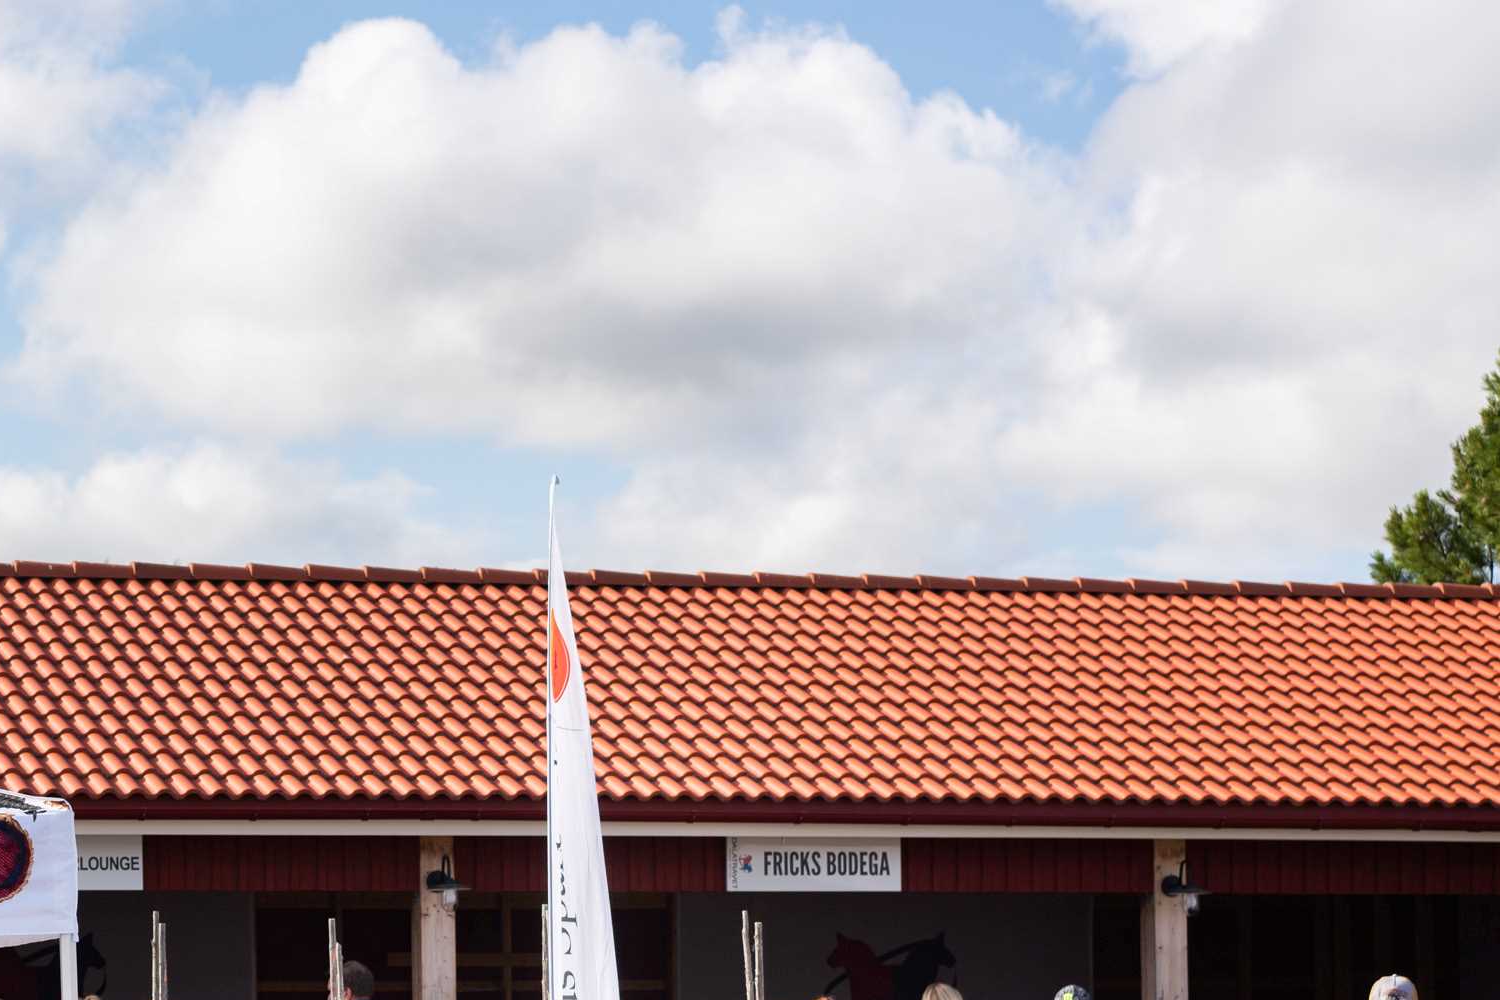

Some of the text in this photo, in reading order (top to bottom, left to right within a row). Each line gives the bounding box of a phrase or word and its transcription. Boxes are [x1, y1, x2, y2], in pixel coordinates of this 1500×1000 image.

[78, 855, 140, 872] LOUNGE
[763, 851, 890, 876] FRICKS BODEGA
